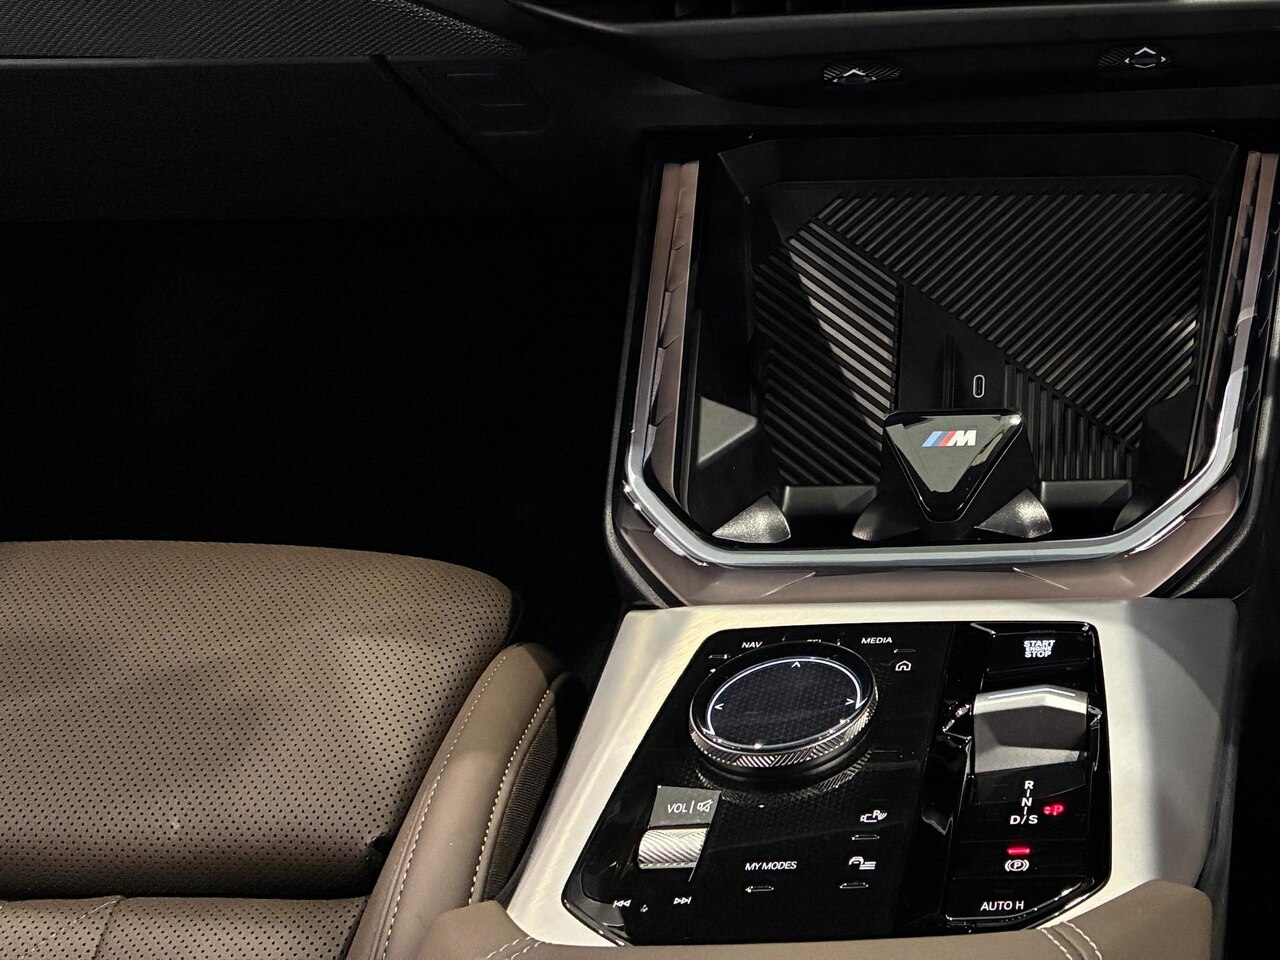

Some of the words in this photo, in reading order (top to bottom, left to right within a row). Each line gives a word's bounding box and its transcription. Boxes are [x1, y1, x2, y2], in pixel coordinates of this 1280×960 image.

[741, 641, 762, 649] NAV
[1023, 639, 1056, 648] START
[1024, 650, 1052, 659] STOP
[1024, 780, 1034, 790] R
[1021, 797, 1032, 807] N
[667, 803, 688, 813] VOL
[745, 862, 762, 871] MY
[763, 861, 797, 870] MODES
[980, 901, 1012, 911] AUTO
[1015, 900, 1025, 911] H
